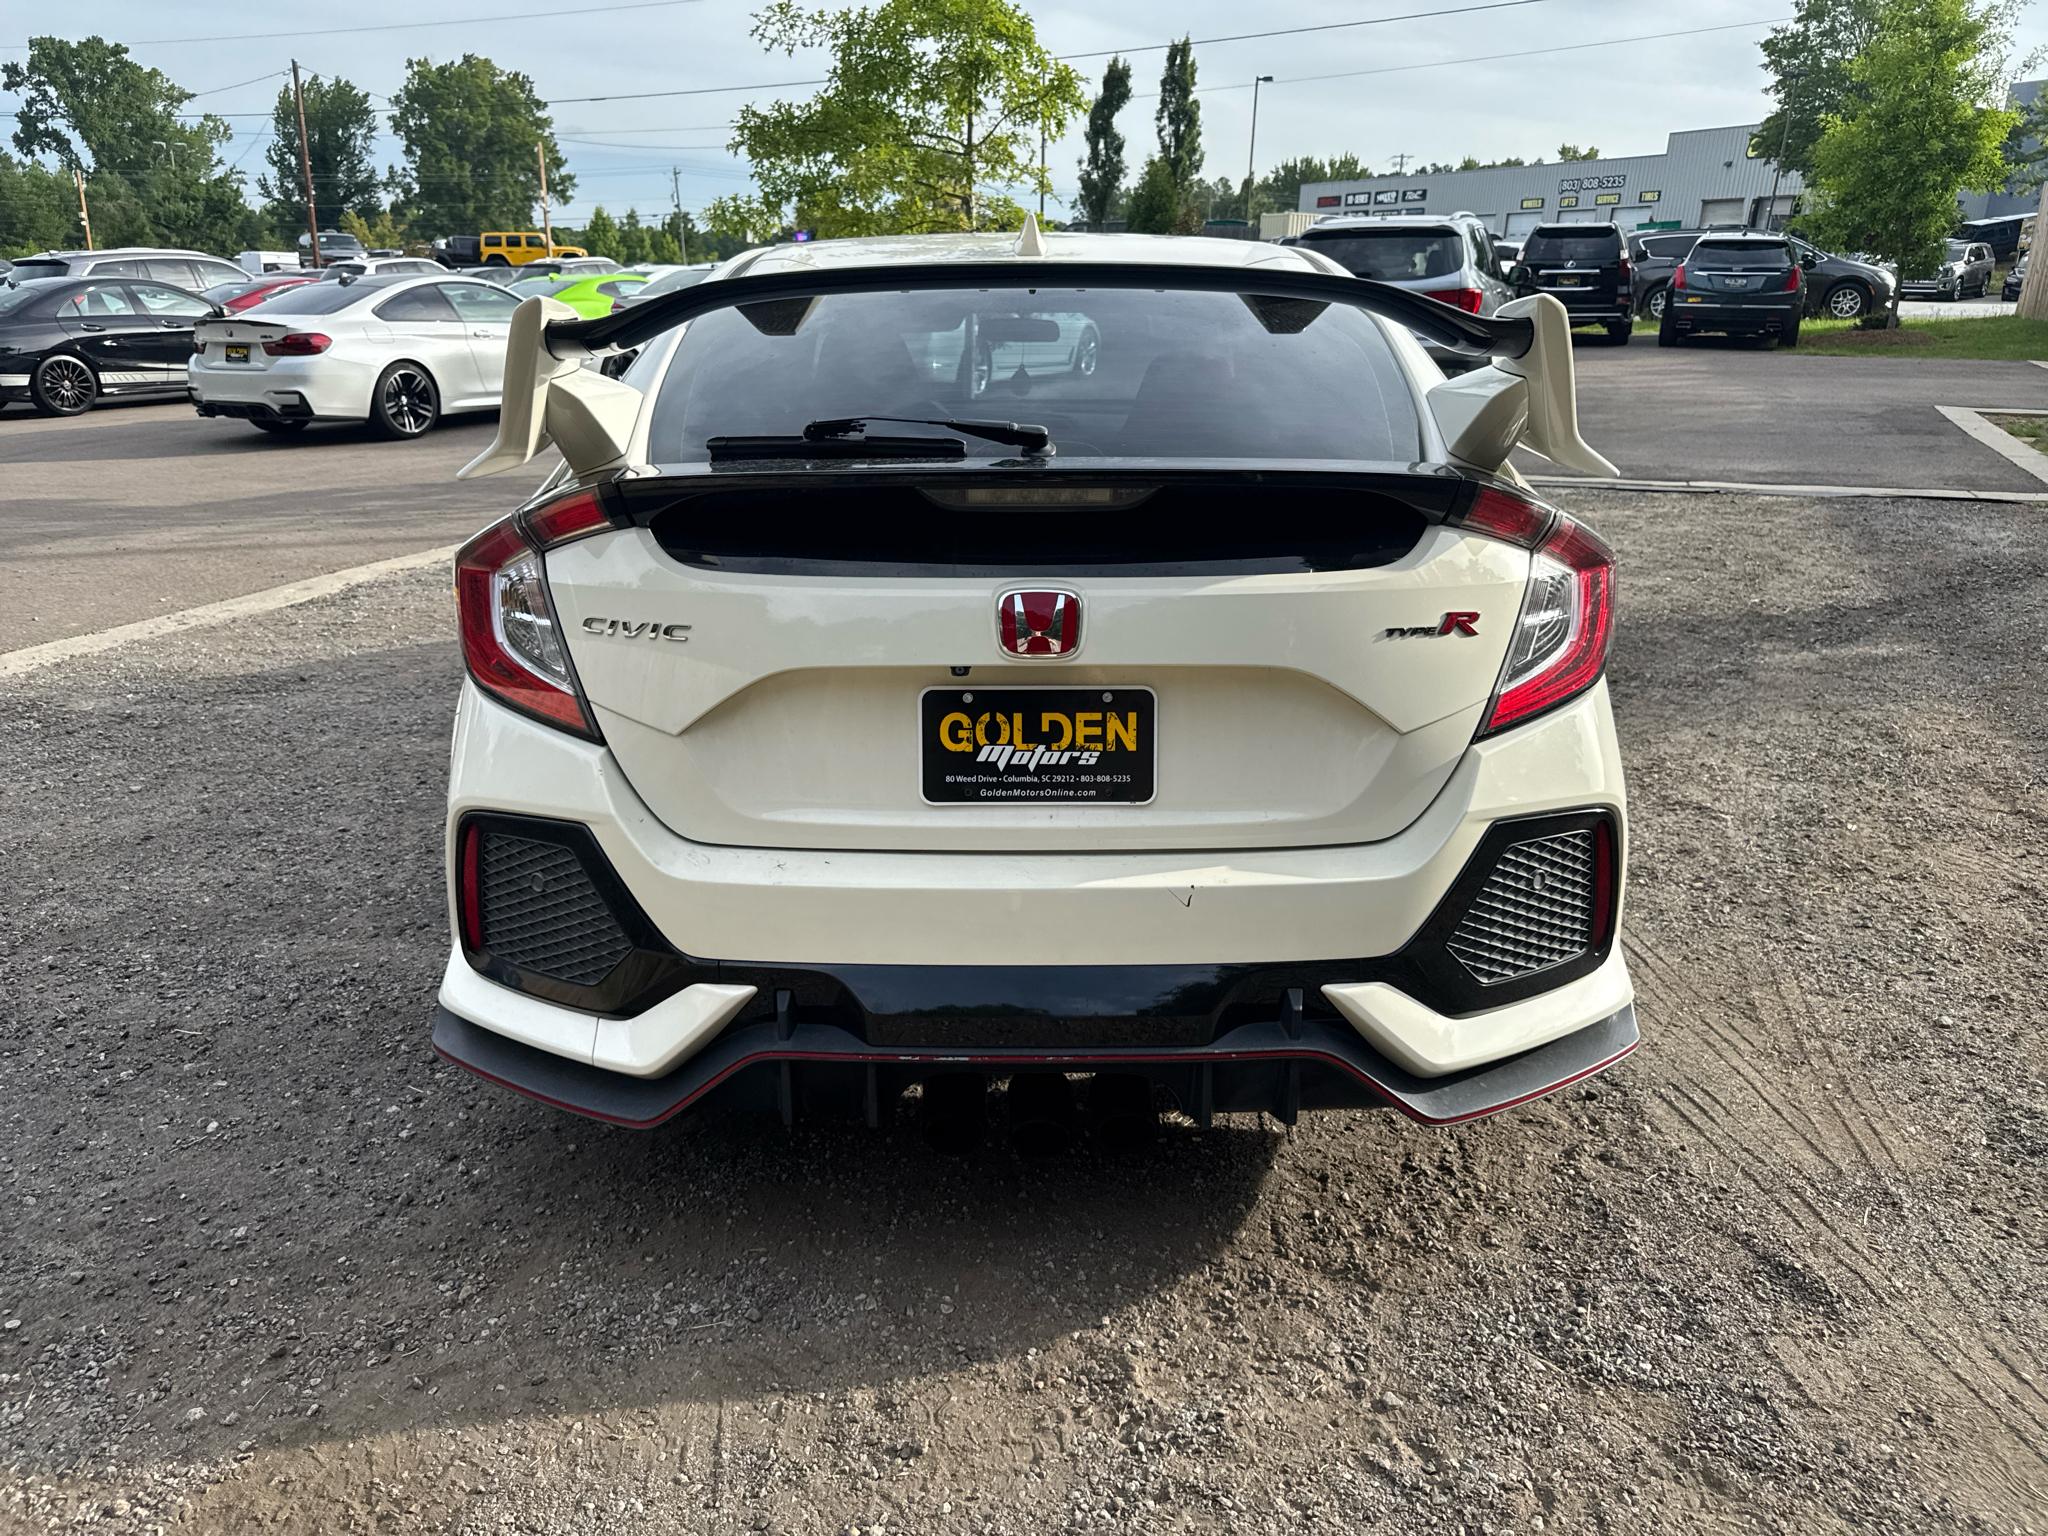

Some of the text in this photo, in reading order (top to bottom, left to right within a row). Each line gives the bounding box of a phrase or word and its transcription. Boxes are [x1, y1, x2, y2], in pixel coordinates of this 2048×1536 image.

[1558, 175, 1625, 194] (803) 808-5235
[1560, 197, 1577, 206] LIFTS
[1596, 194, 1620, 204] SERVICE
[1641, 191, 1659, 201] TIRES
[582, 617, 692, 641] CIVIC
[1380, 611, 1481, 639] TYPE R
[939, 711, 1138, 752] GOLDEN
[975, 744, 1101, 773] Motors
[945, 774, 1131, 784] 80 Weed Drive Columbia, SC 29212 803-808-5235
[980, 788, 1097, 797] GoldenMotorsOnline.com
